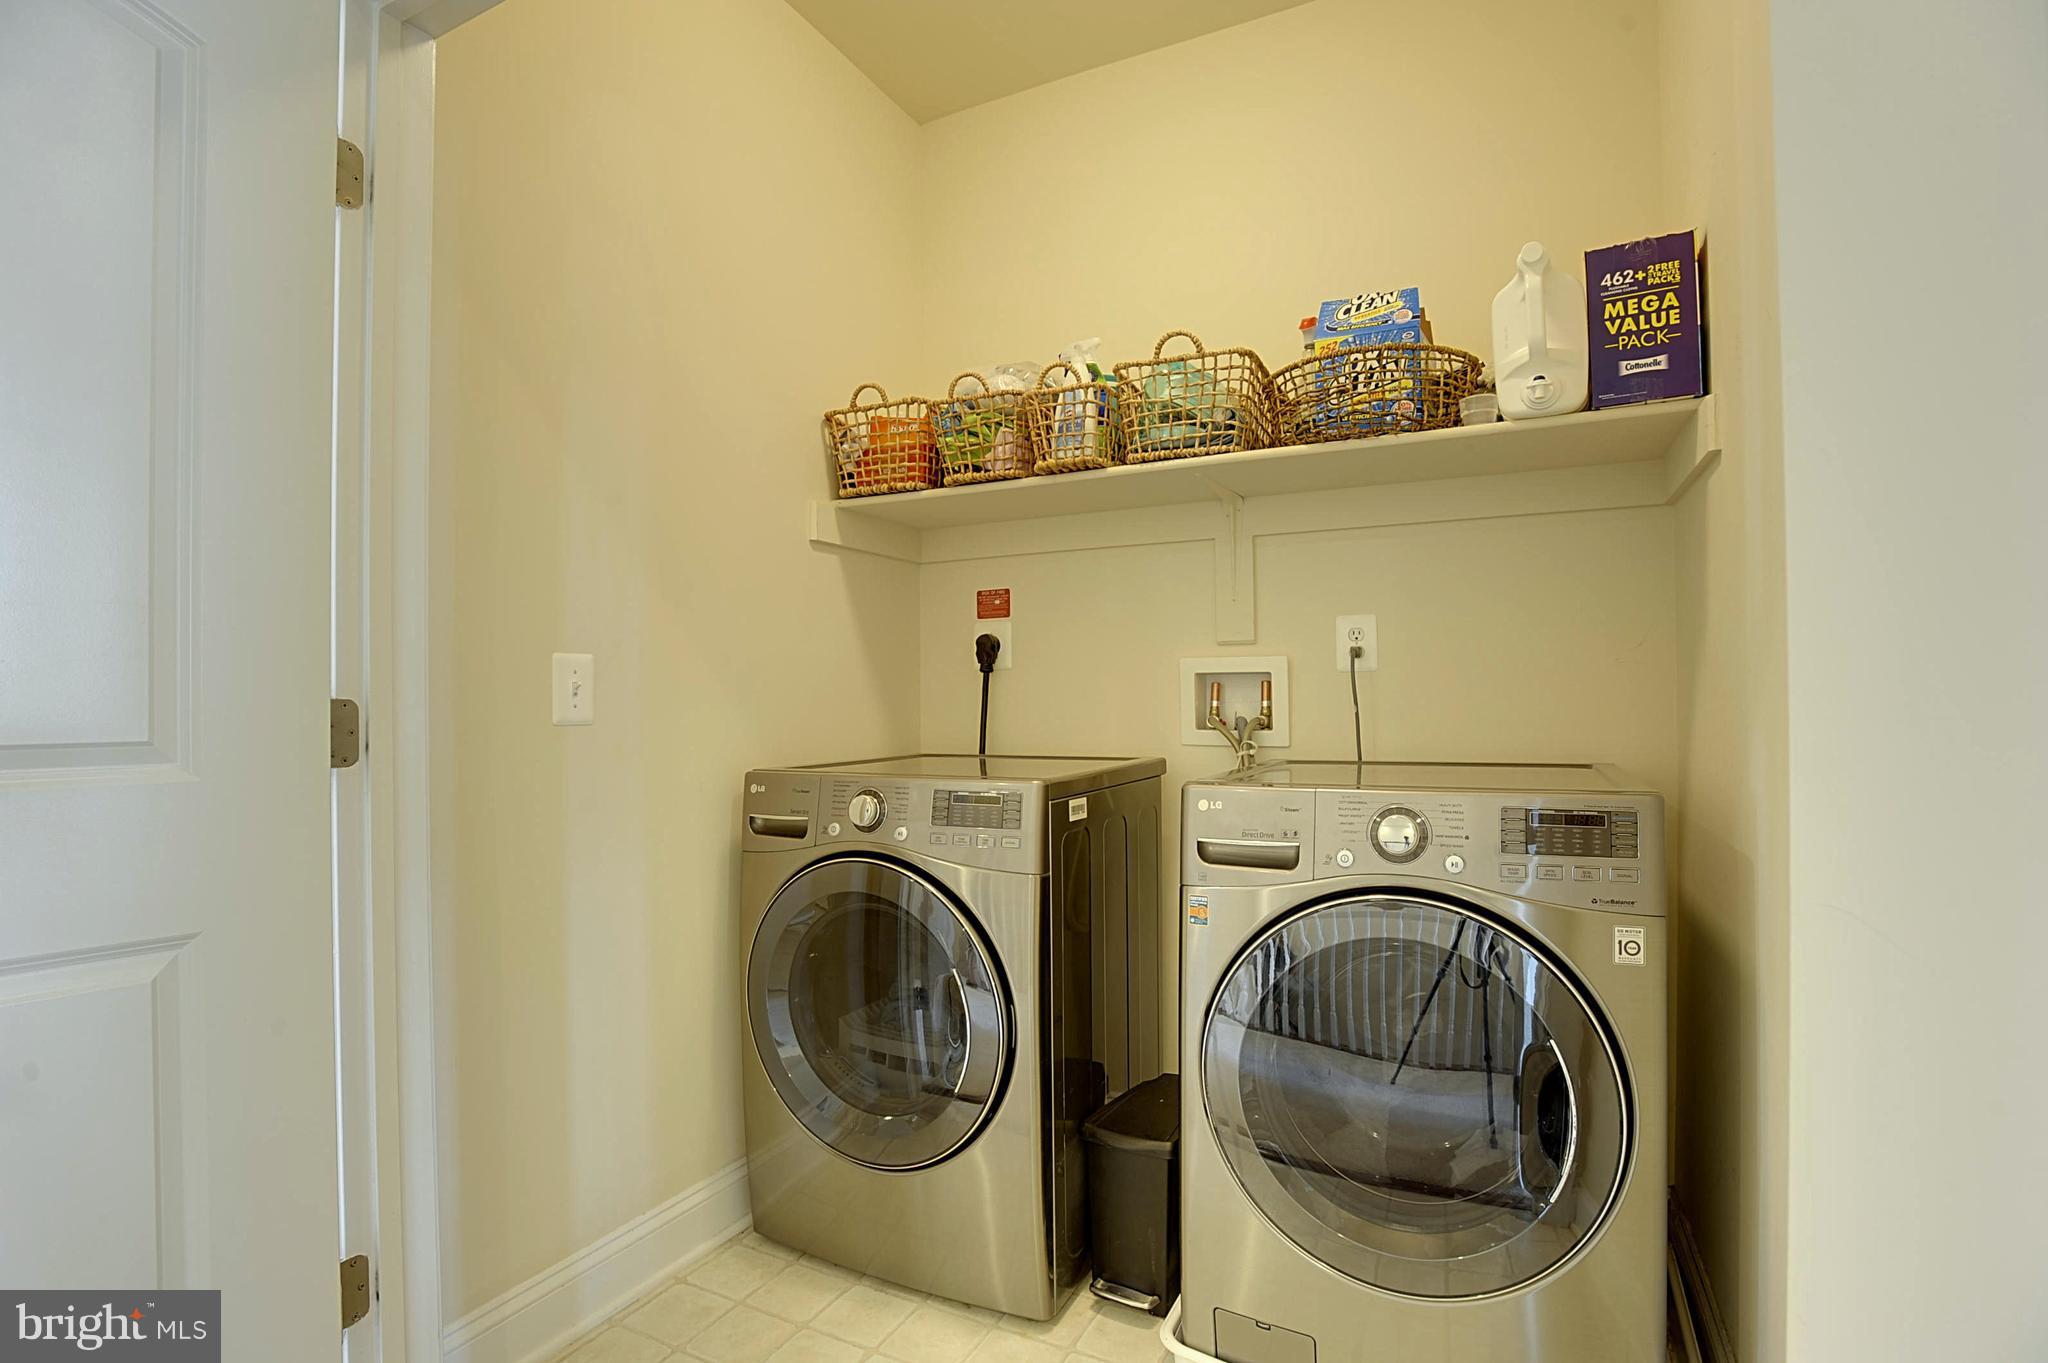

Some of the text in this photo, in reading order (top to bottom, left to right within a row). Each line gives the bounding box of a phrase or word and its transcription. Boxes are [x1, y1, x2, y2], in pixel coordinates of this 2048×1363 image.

[1647, 273, 1681, 286] PACKS
[1335, 290, 1400, 320] CLEAN
[1603, 291, 1679, 319] MEGA
[1604, 309, 1681, 335] VALUE
[1619, 328, 1669, 350] PACK
[1625, 359, 1663, 372] Cottonelle
[1617, 939, 1642, 956] 10
